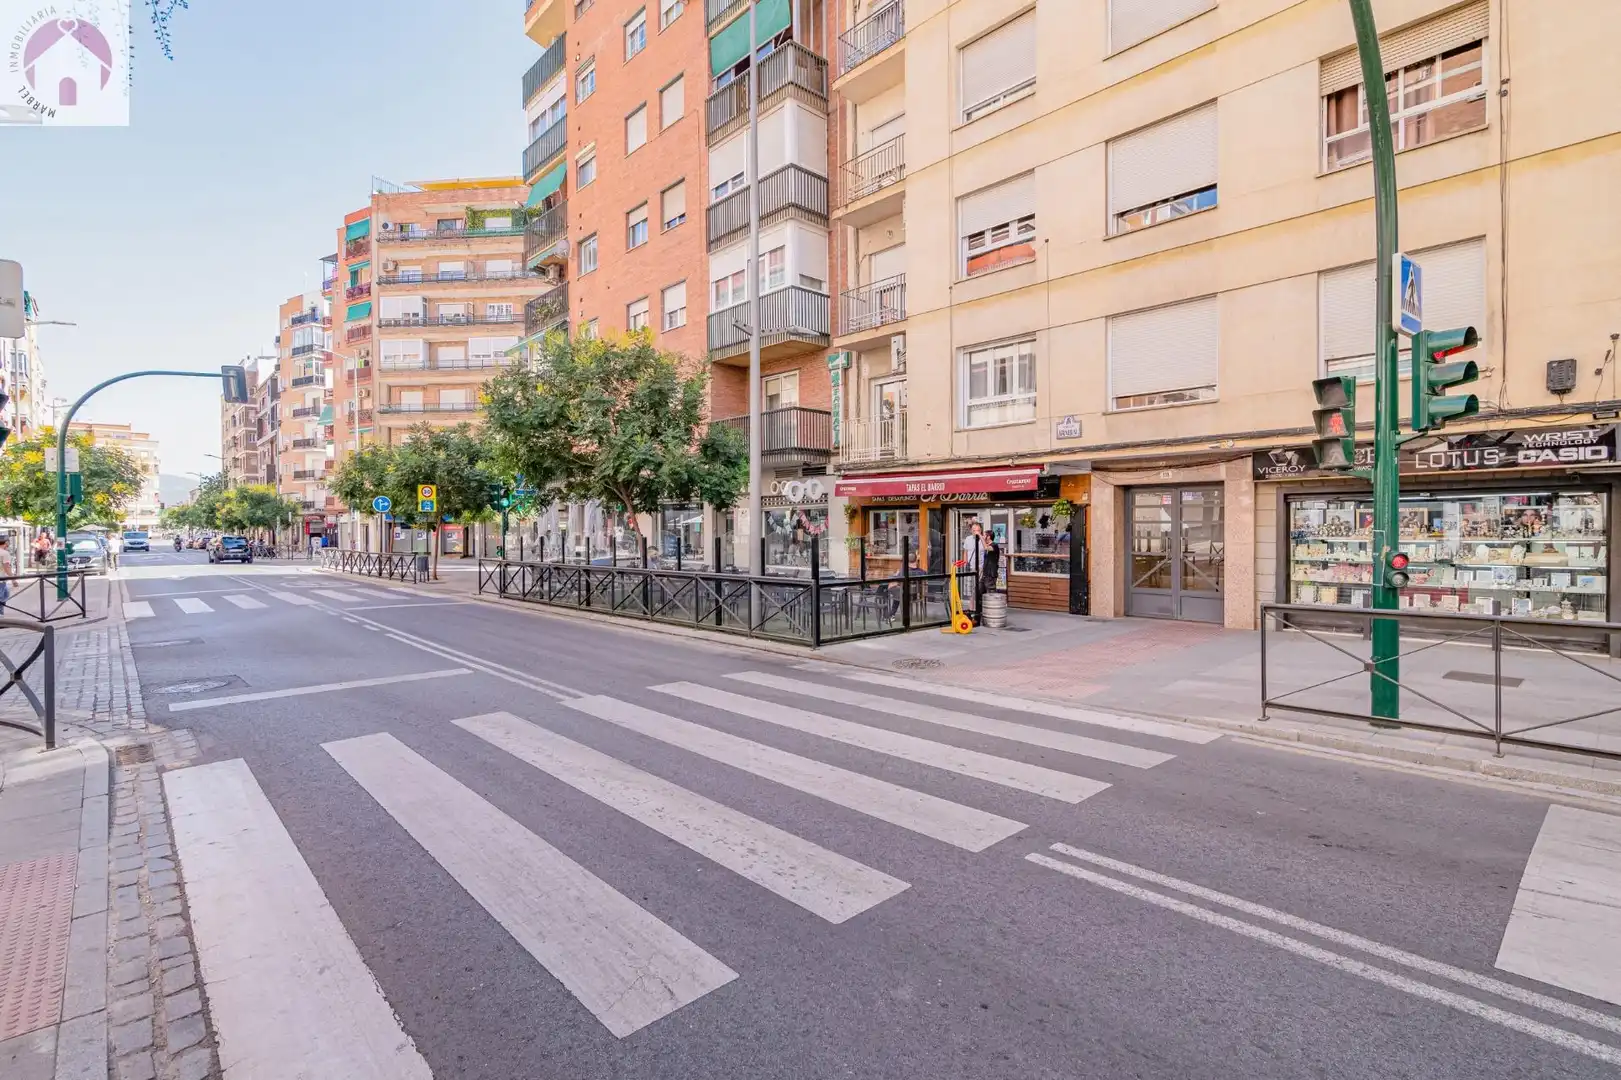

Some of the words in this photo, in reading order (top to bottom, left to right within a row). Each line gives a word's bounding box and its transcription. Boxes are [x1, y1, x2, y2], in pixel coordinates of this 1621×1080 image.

[1524, 429, 1600, 443] WRIST
[1522, 438, 1598, 448] TECHNOLOGY
[1415, 449, 1500, 469] LOTUS
[1517, 446, 1608, 463] CASIO
[1257, 465, 1306, 474] VICEROY
[906, 483, 920, 492] TAPAS
[921, 483, 927, 492] EL
